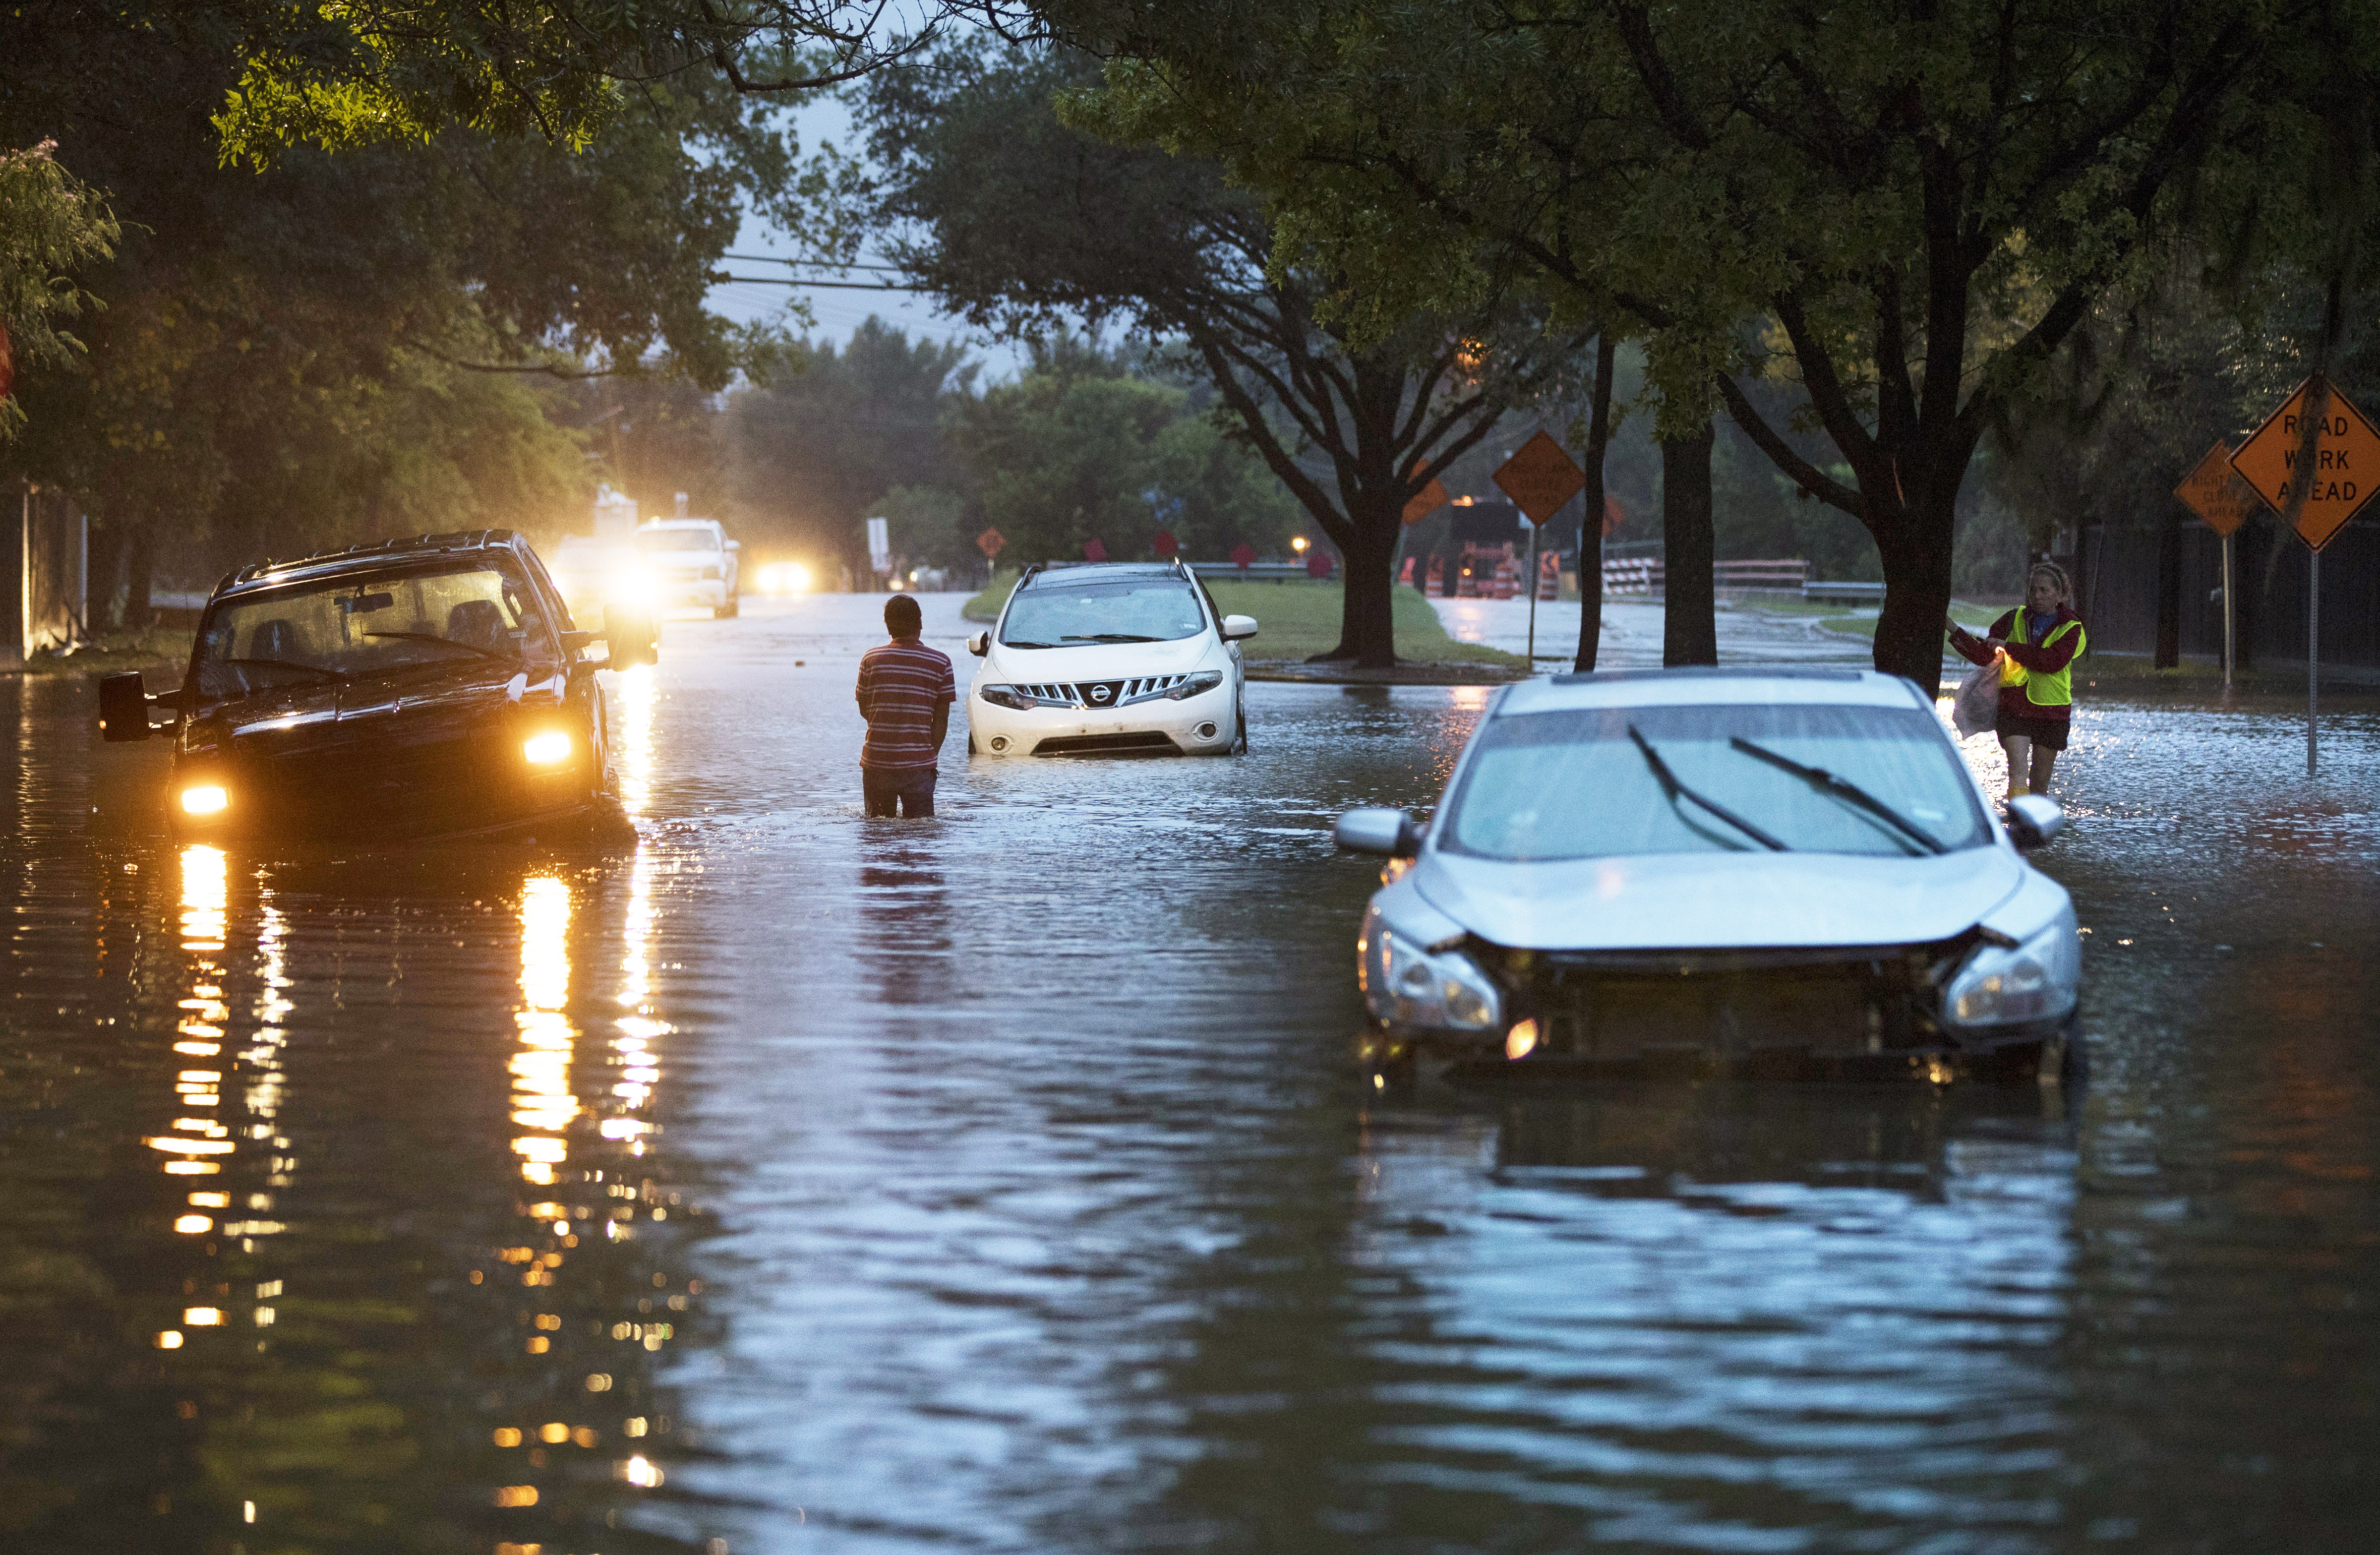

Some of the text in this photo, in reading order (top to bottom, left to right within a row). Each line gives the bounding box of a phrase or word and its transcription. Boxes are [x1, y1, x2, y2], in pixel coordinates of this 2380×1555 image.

[2284, 415, 2348, 436] RAD
[2284, 450, 2349, 470] WRK
[2277, 481, 2357, 501] AEAD
